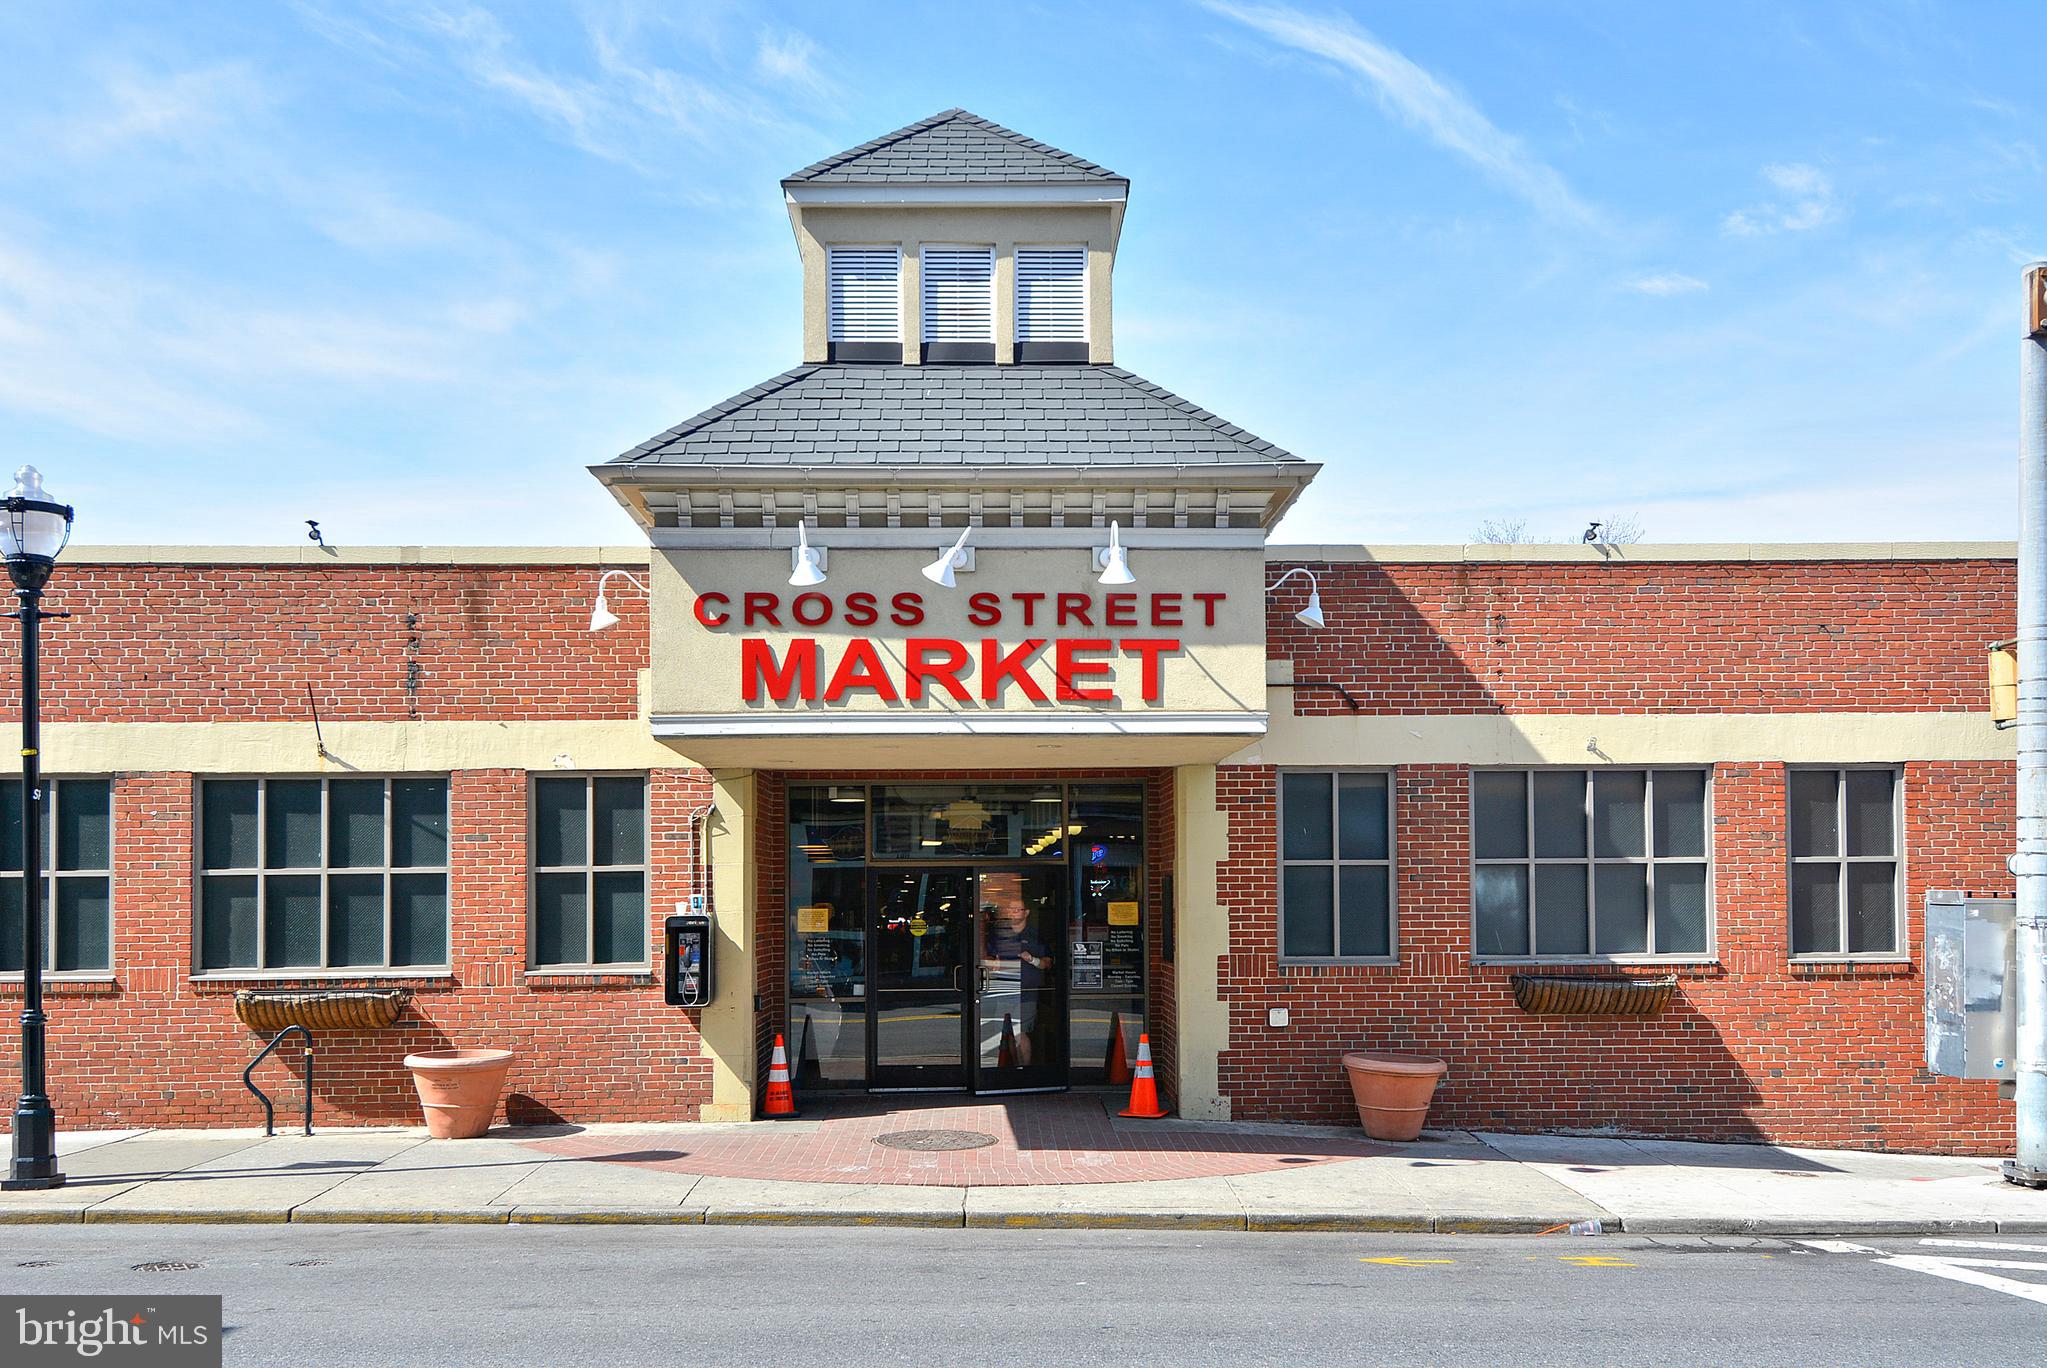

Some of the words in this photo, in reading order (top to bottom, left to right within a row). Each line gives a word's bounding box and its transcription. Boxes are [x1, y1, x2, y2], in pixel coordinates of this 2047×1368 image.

[694, 592, 925, 626] CROSS
[967, 592, 1227, 626] STREET
[741, 638, 1180, 700] MARKET
